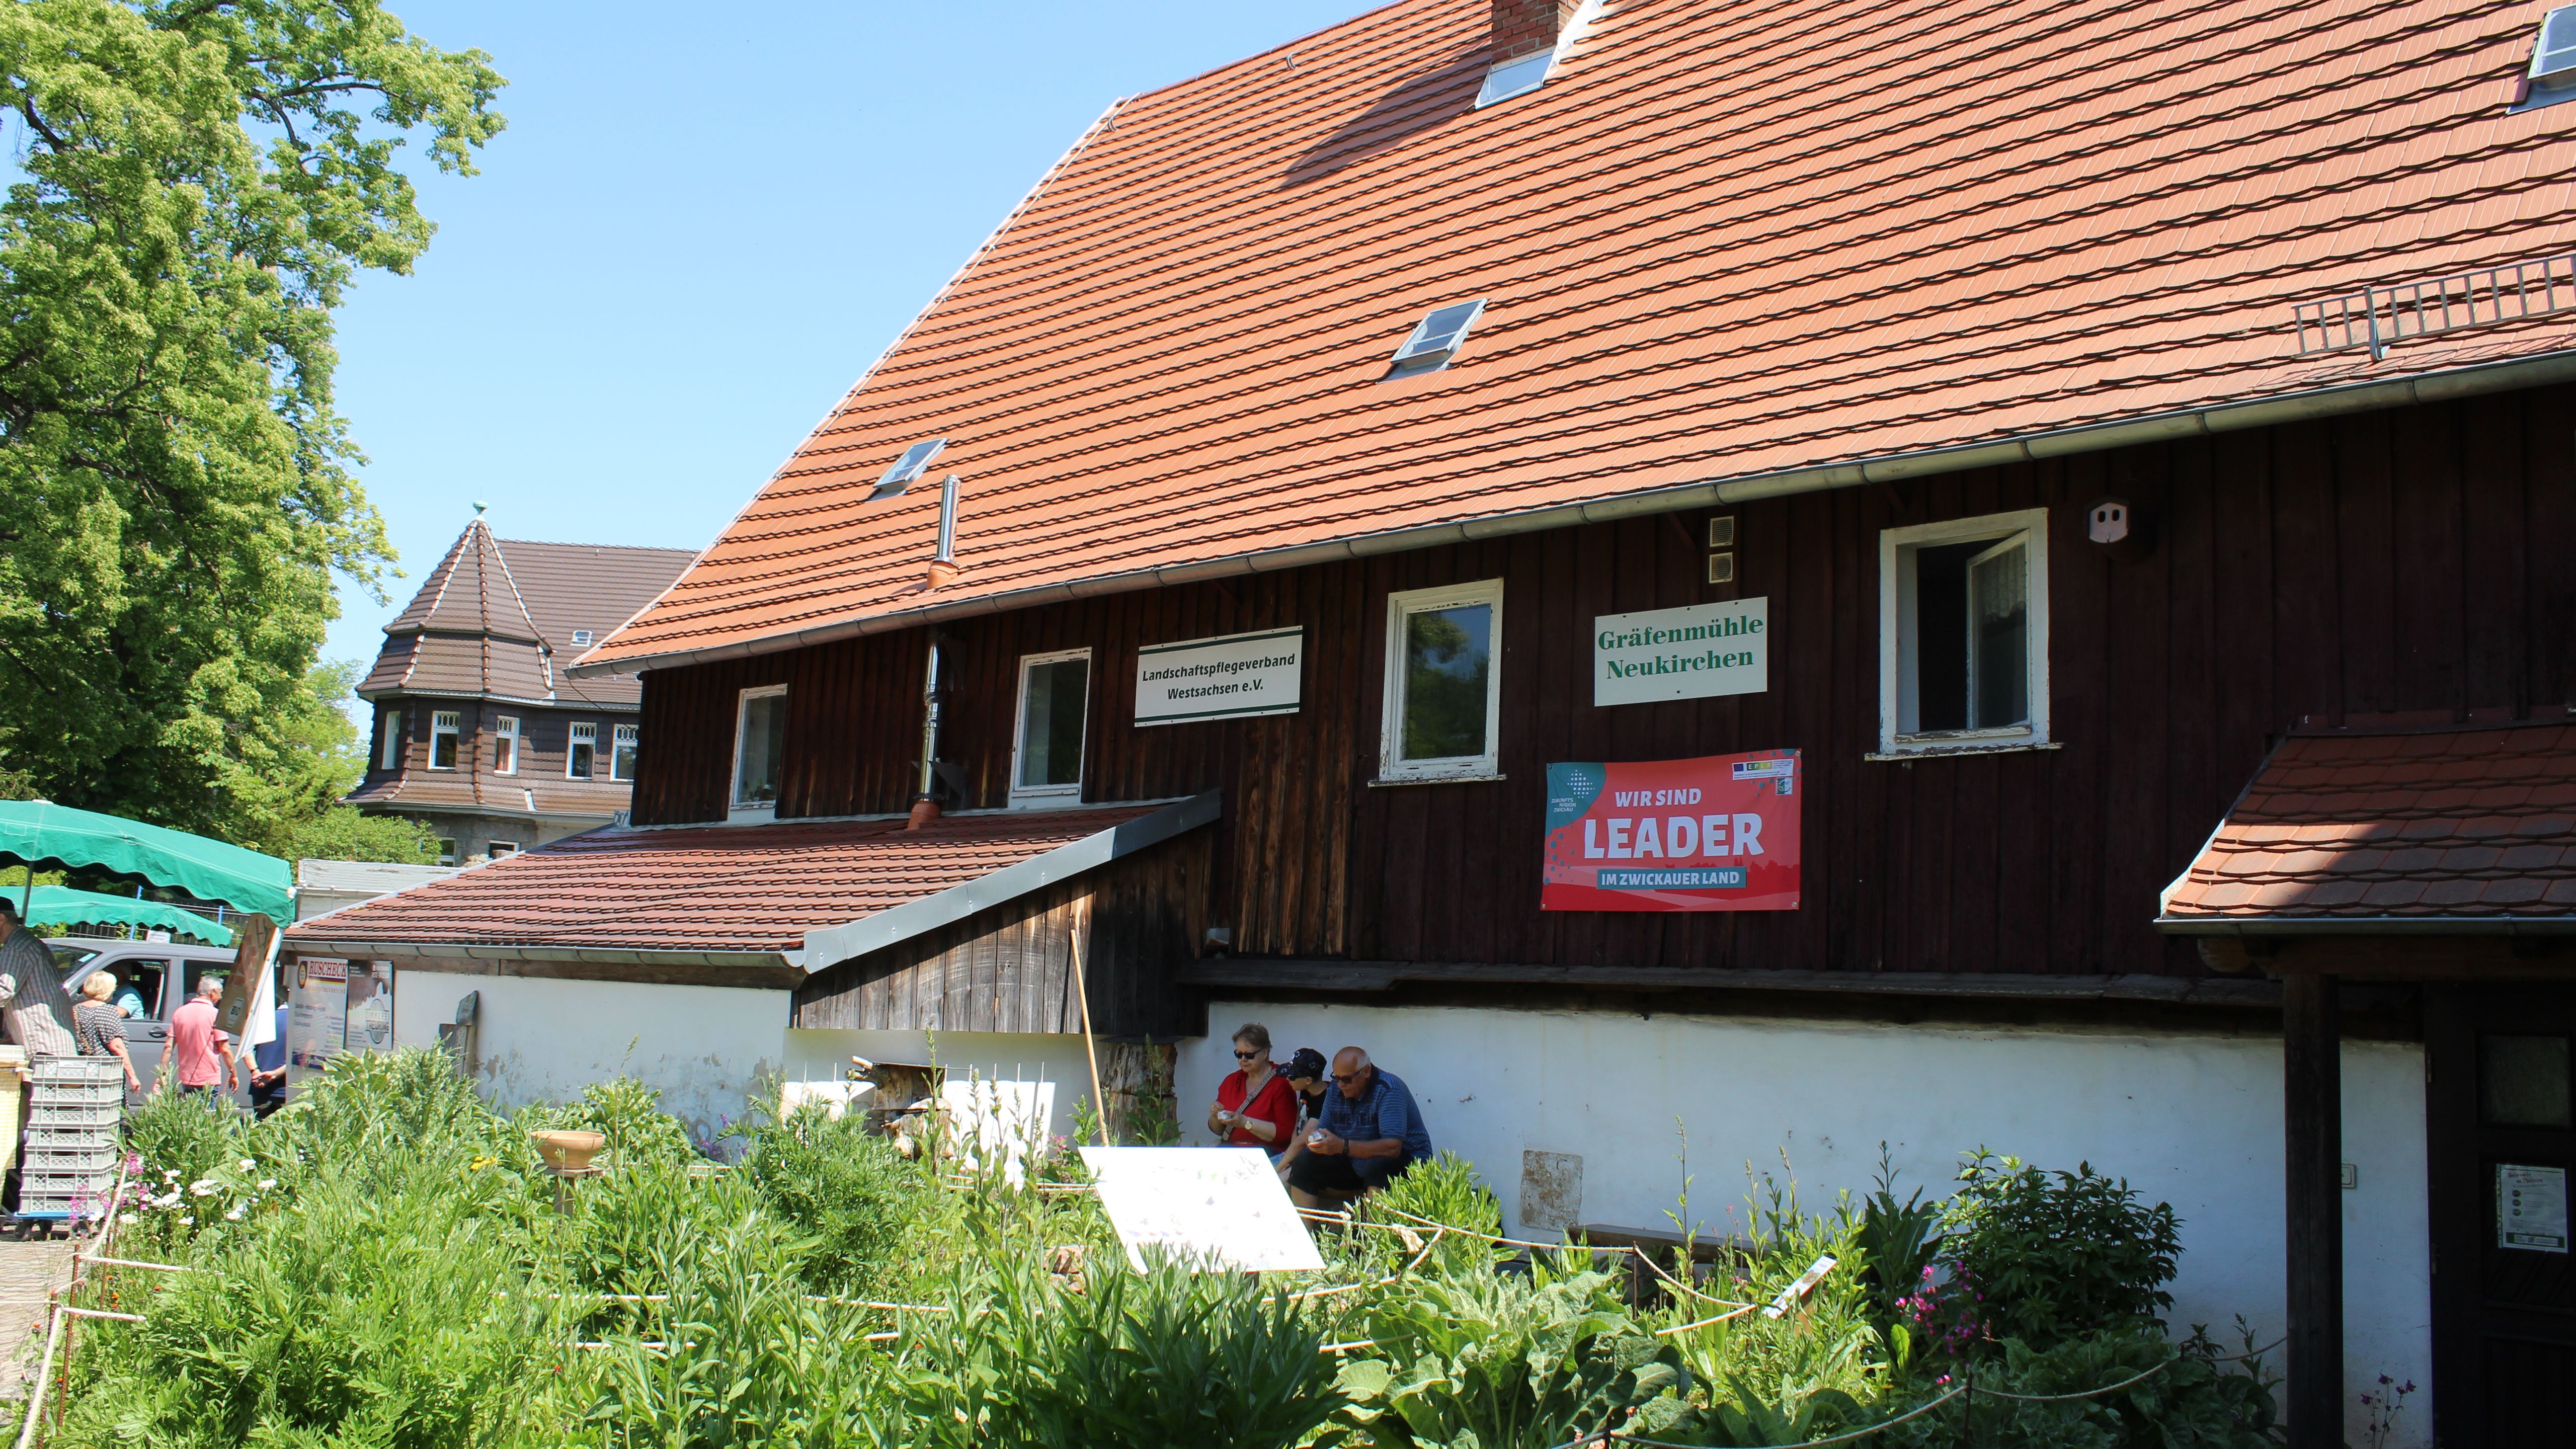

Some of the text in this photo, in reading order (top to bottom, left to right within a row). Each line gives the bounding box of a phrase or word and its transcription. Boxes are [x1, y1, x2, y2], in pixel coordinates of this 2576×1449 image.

[1598, 615, 1763, 650] Gräfenmühle
[1142, 653, 1295, 681] Landschaftspflegeverband
[1607, 650, 1754, 679] Neukirchen
[1168, 679, 1263, 700] Westsachsen e.V.
[1615, 788, 1702, 807] WIR SIND
[1584, 813, 1765, 859] LEADER
[1601, 871, 1740, 886] IM ZWICKAUER LAND
